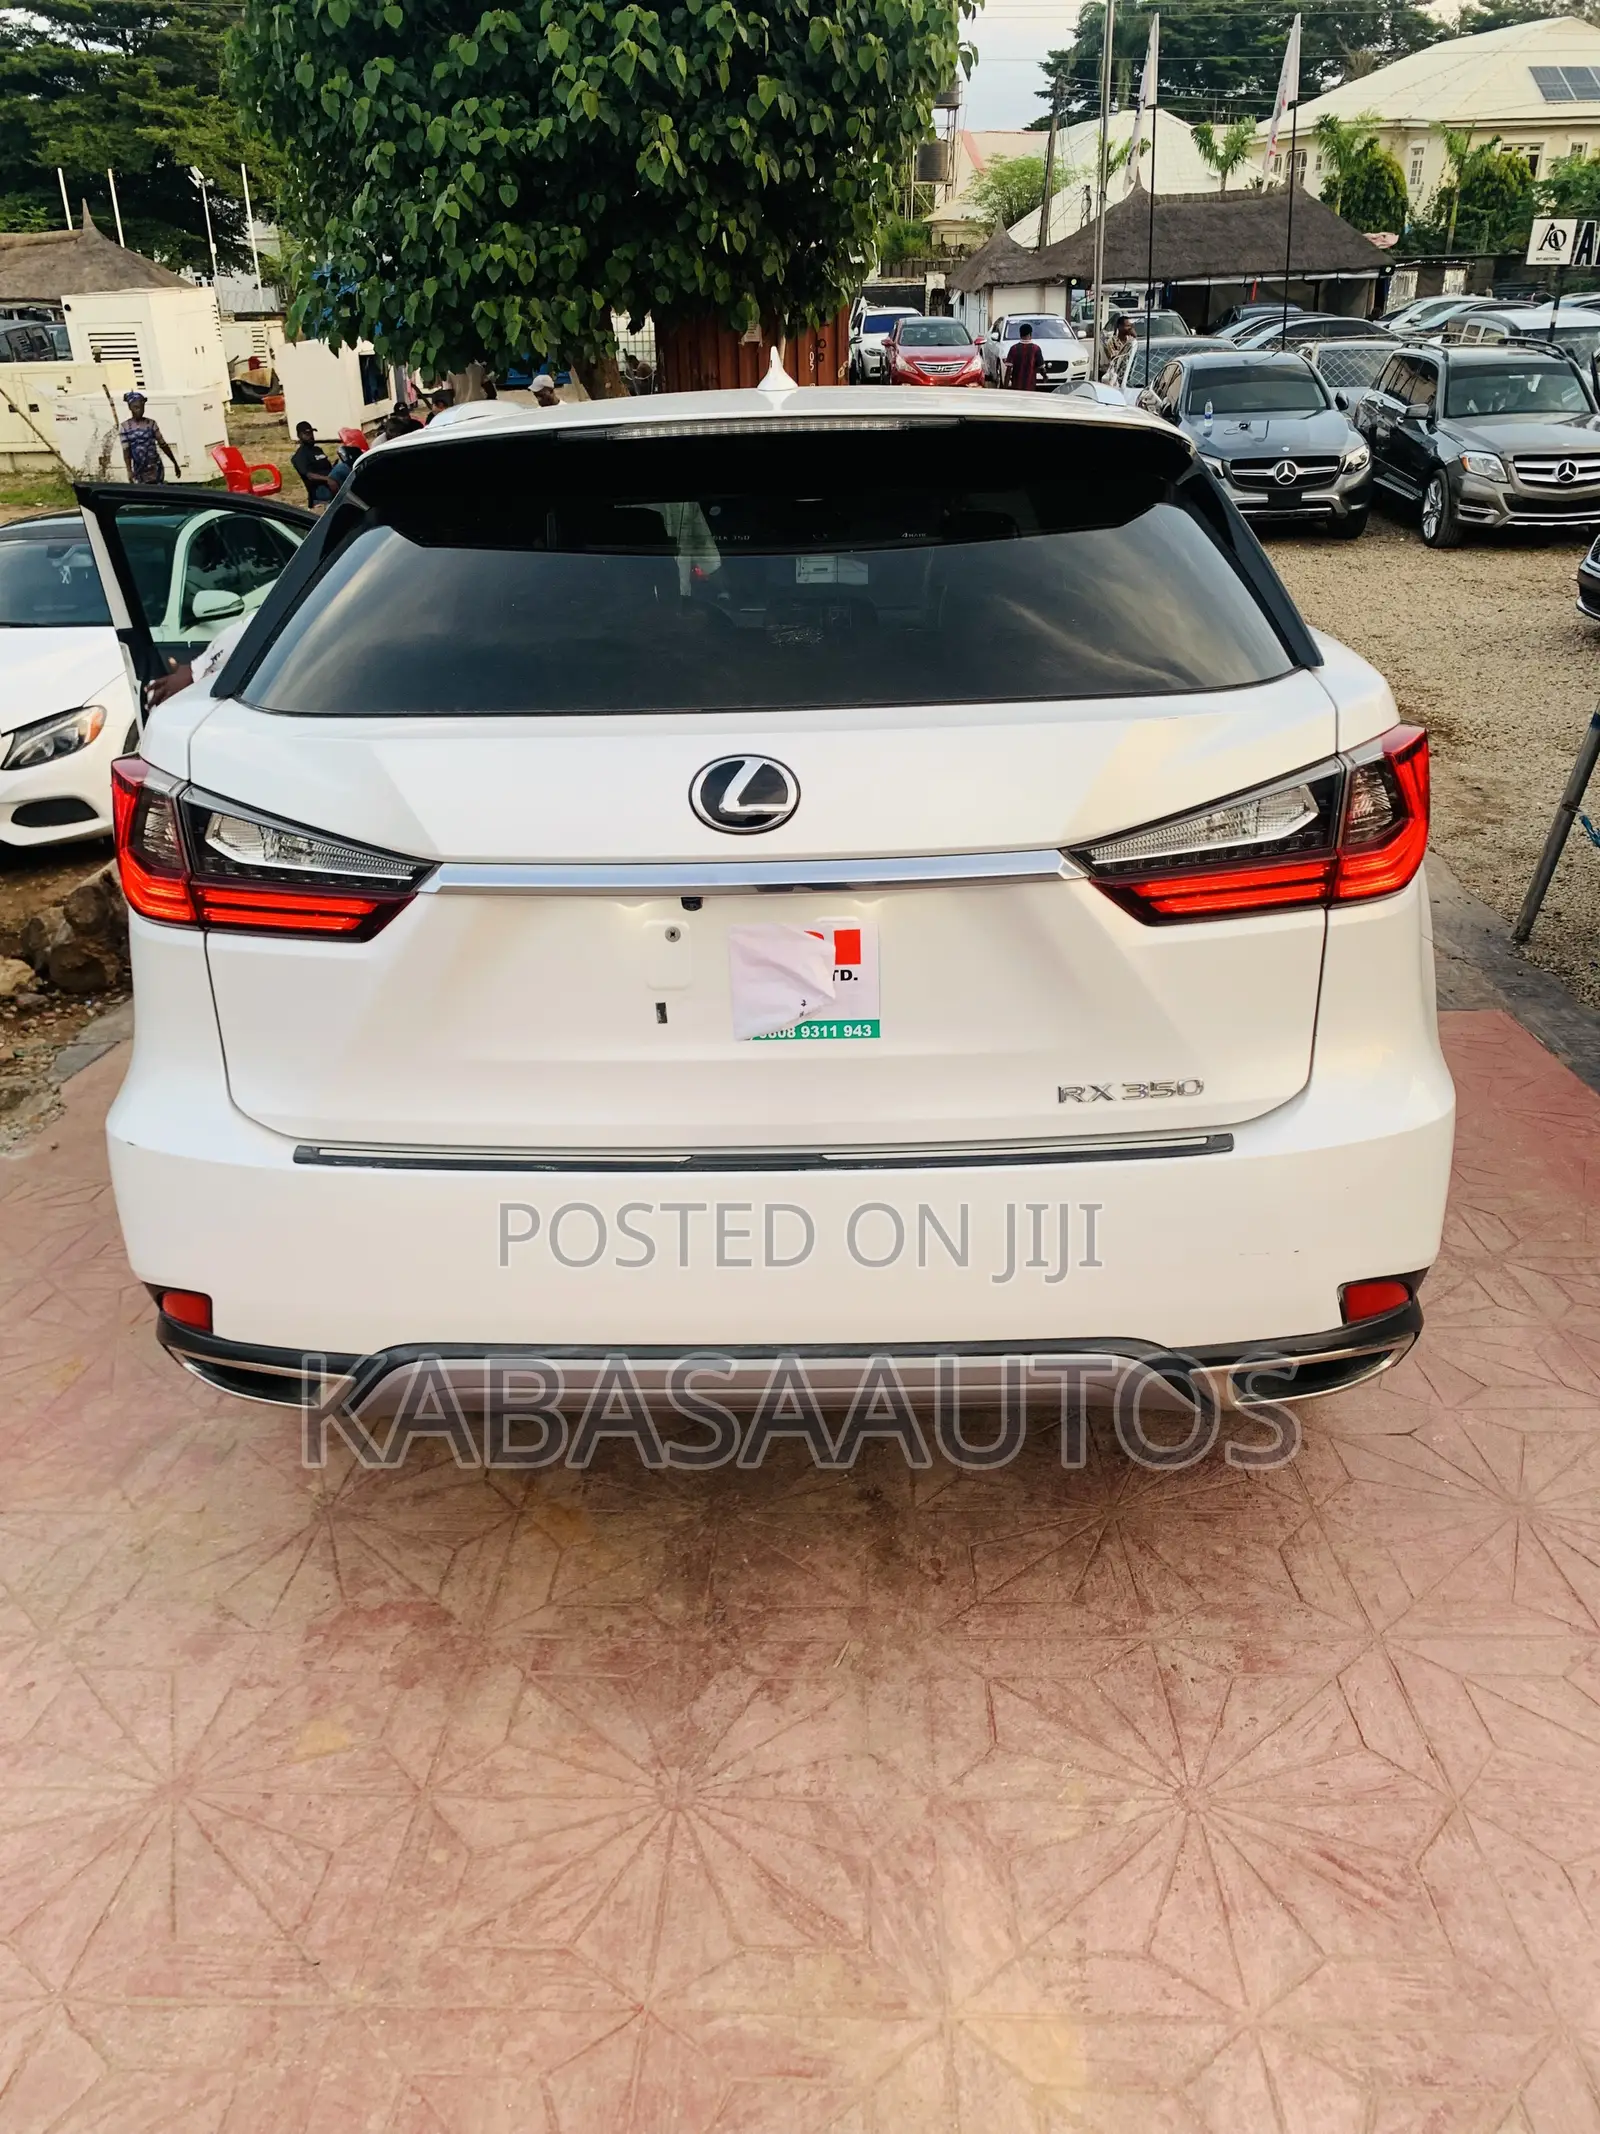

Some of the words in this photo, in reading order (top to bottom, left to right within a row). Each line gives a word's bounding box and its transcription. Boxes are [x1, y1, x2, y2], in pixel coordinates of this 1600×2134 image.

[1572, 220, 1600, 267] A
[801, 1025, 838, 1038] 9311
[843, 1024, 872, 1037] 943
[1057, 1083, 1116, 1104] RX
[1121, 1077, 1205, 1101] 350
